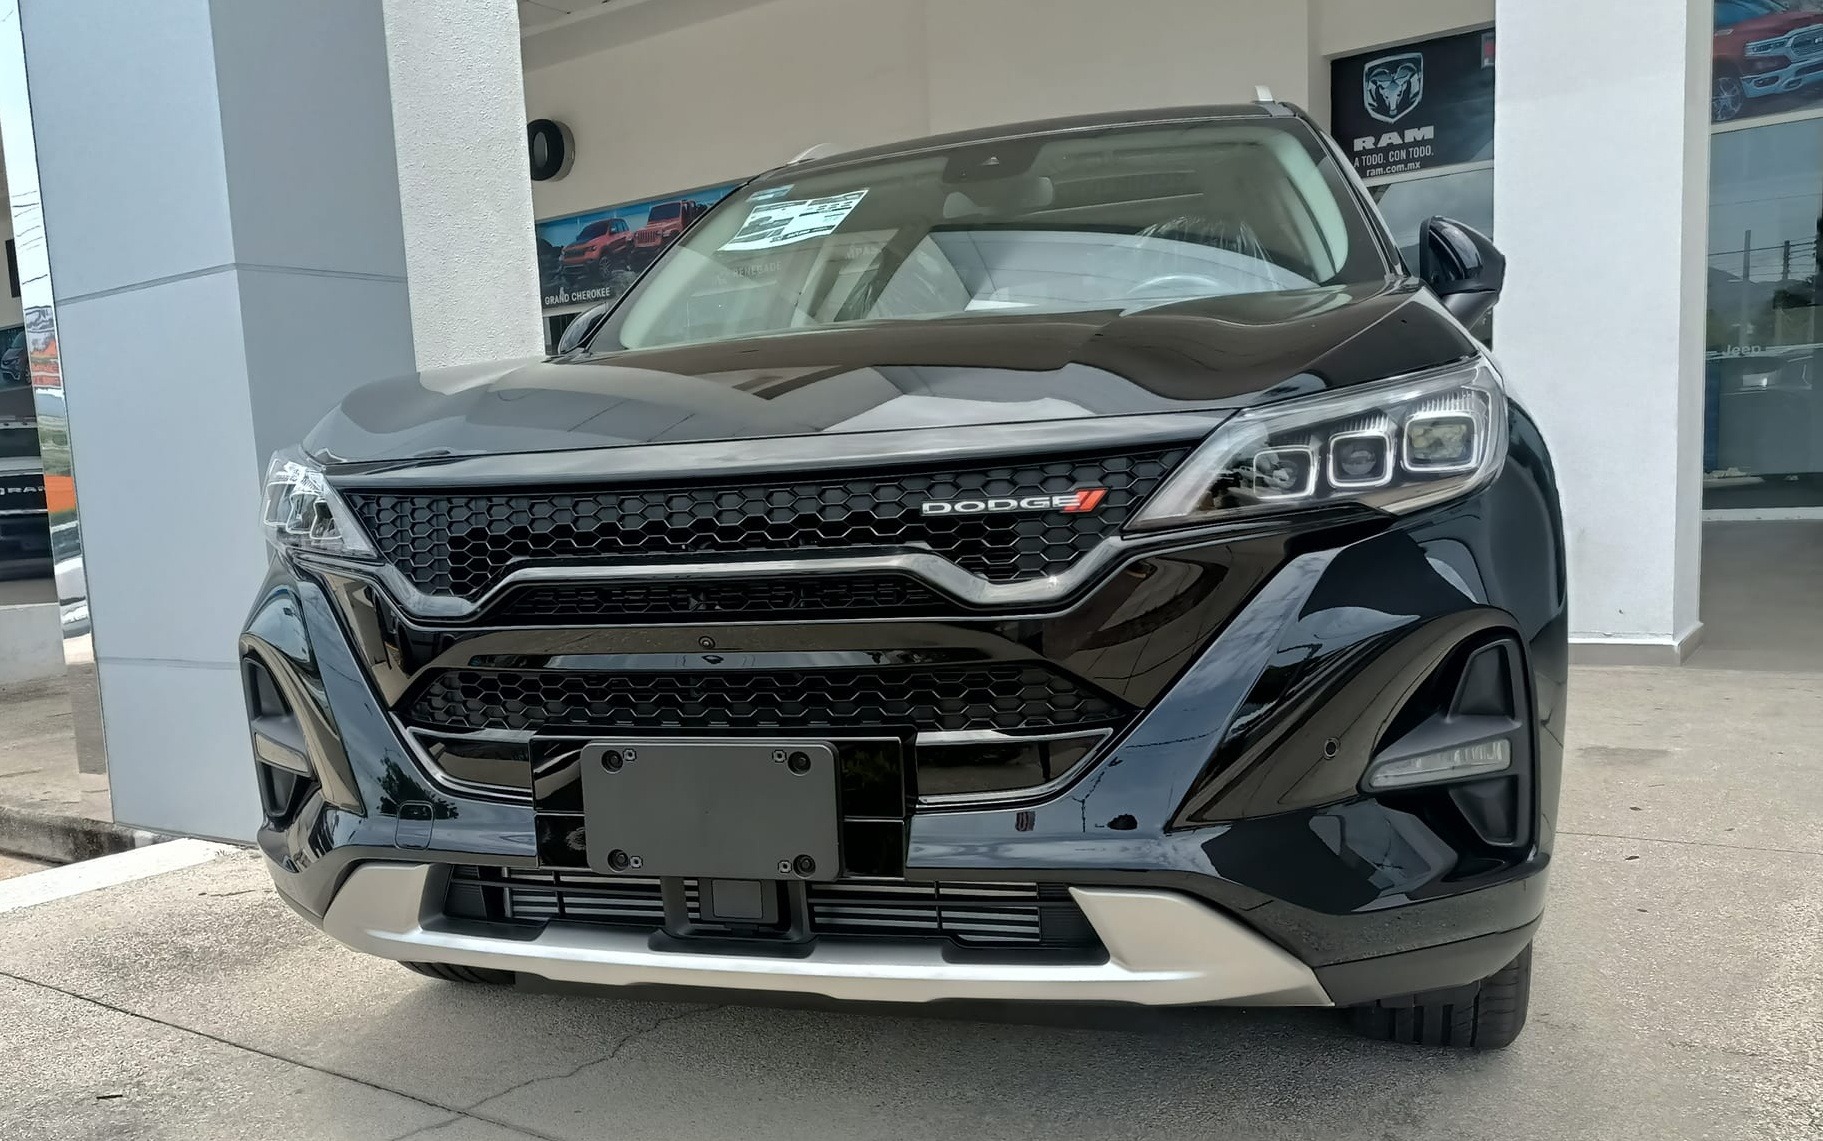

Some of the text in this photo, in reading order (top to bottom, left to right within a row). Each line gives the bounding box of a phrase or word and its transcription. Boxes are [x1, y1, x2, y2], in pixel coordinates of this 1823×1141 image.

[1353, 125, 1434, 152] RAM
[1353, 145, 1434, 168] A TODO. CON TODO.
[1366, 161, 1421, 177] ram.com.mx
[544, 287, 611, 305] GRAND CHEROKEE
[922, 494, 1081, 514] DODGE
